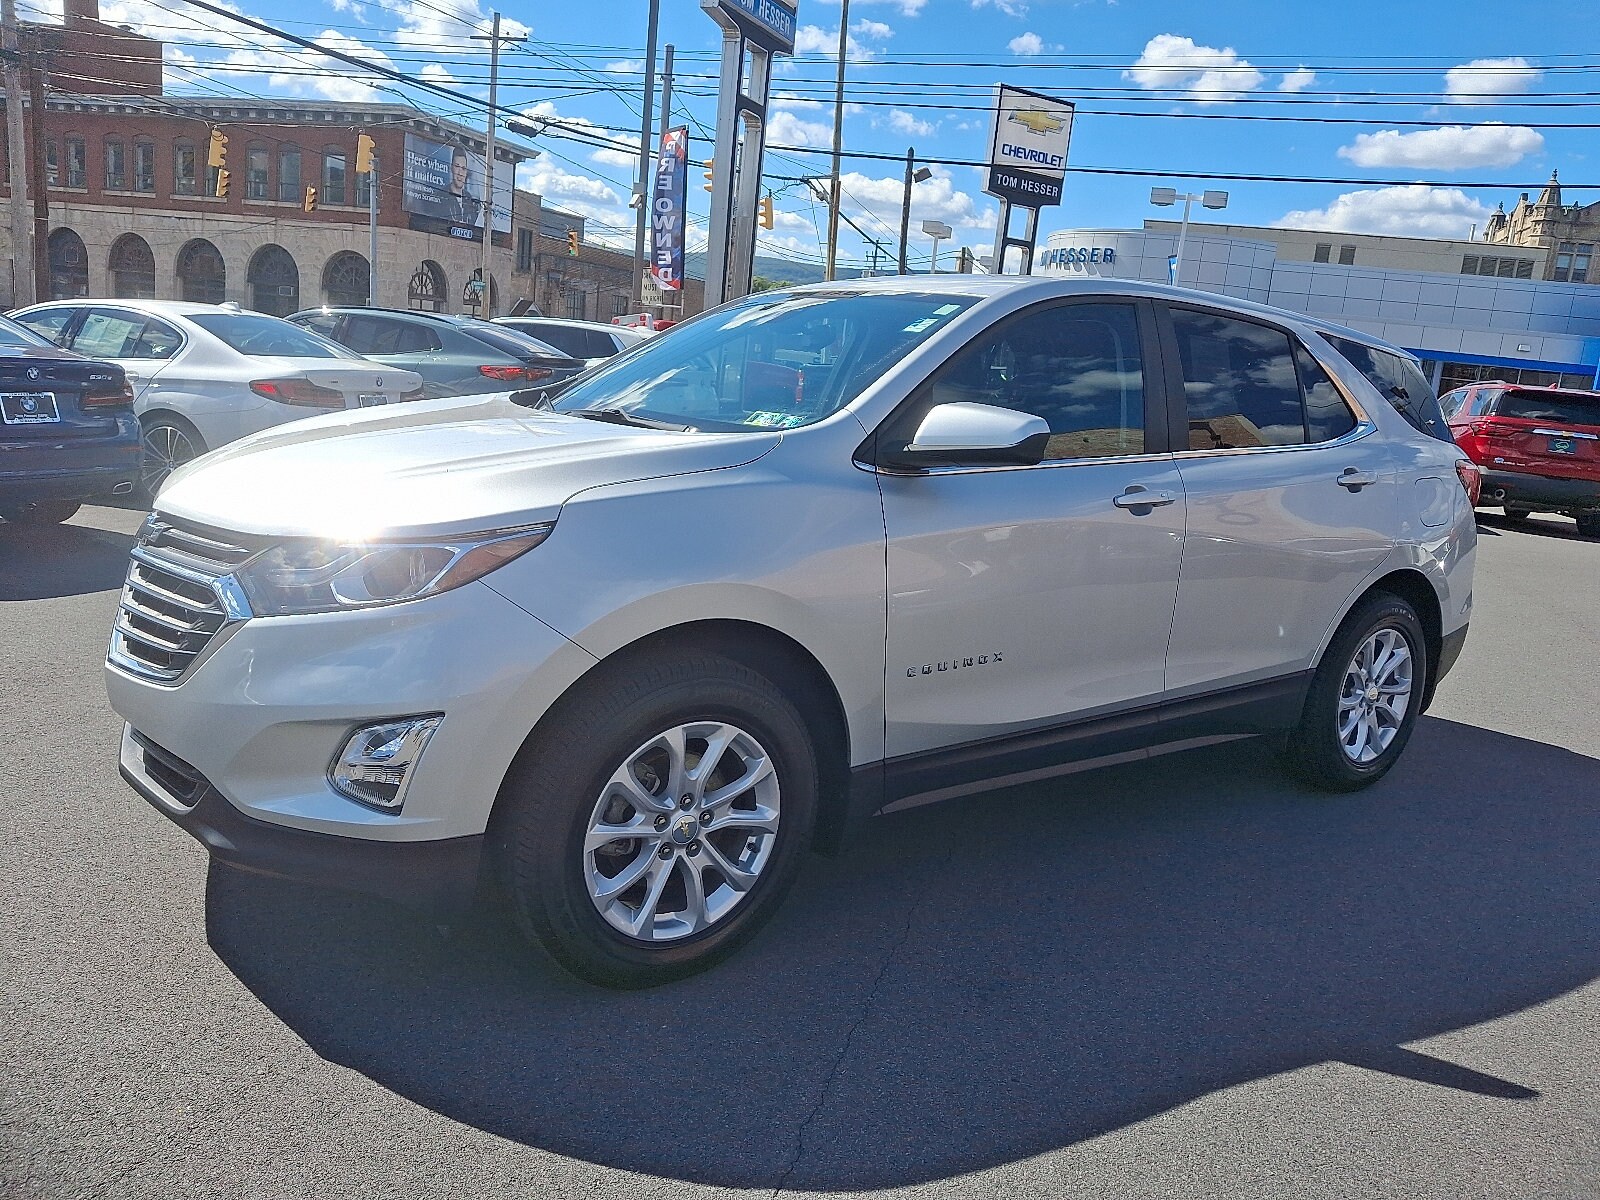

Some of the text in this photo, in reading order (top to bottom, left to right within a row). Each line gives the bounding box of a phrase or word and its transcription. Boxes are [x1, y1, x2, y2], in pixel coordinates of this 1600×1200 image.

[759, 0, 791, 35] HESSER
[407, 151, 449, 174] Here when
[1001, 143, 1064, 168] CHEVROLET
[407, 166, 446, 186] it matters.
[996, 173, 1059, 198] TOM HESSER
[1051, 247, 1114, 264] HESSER
[906, 651, 1003, 678] EQUINOX
